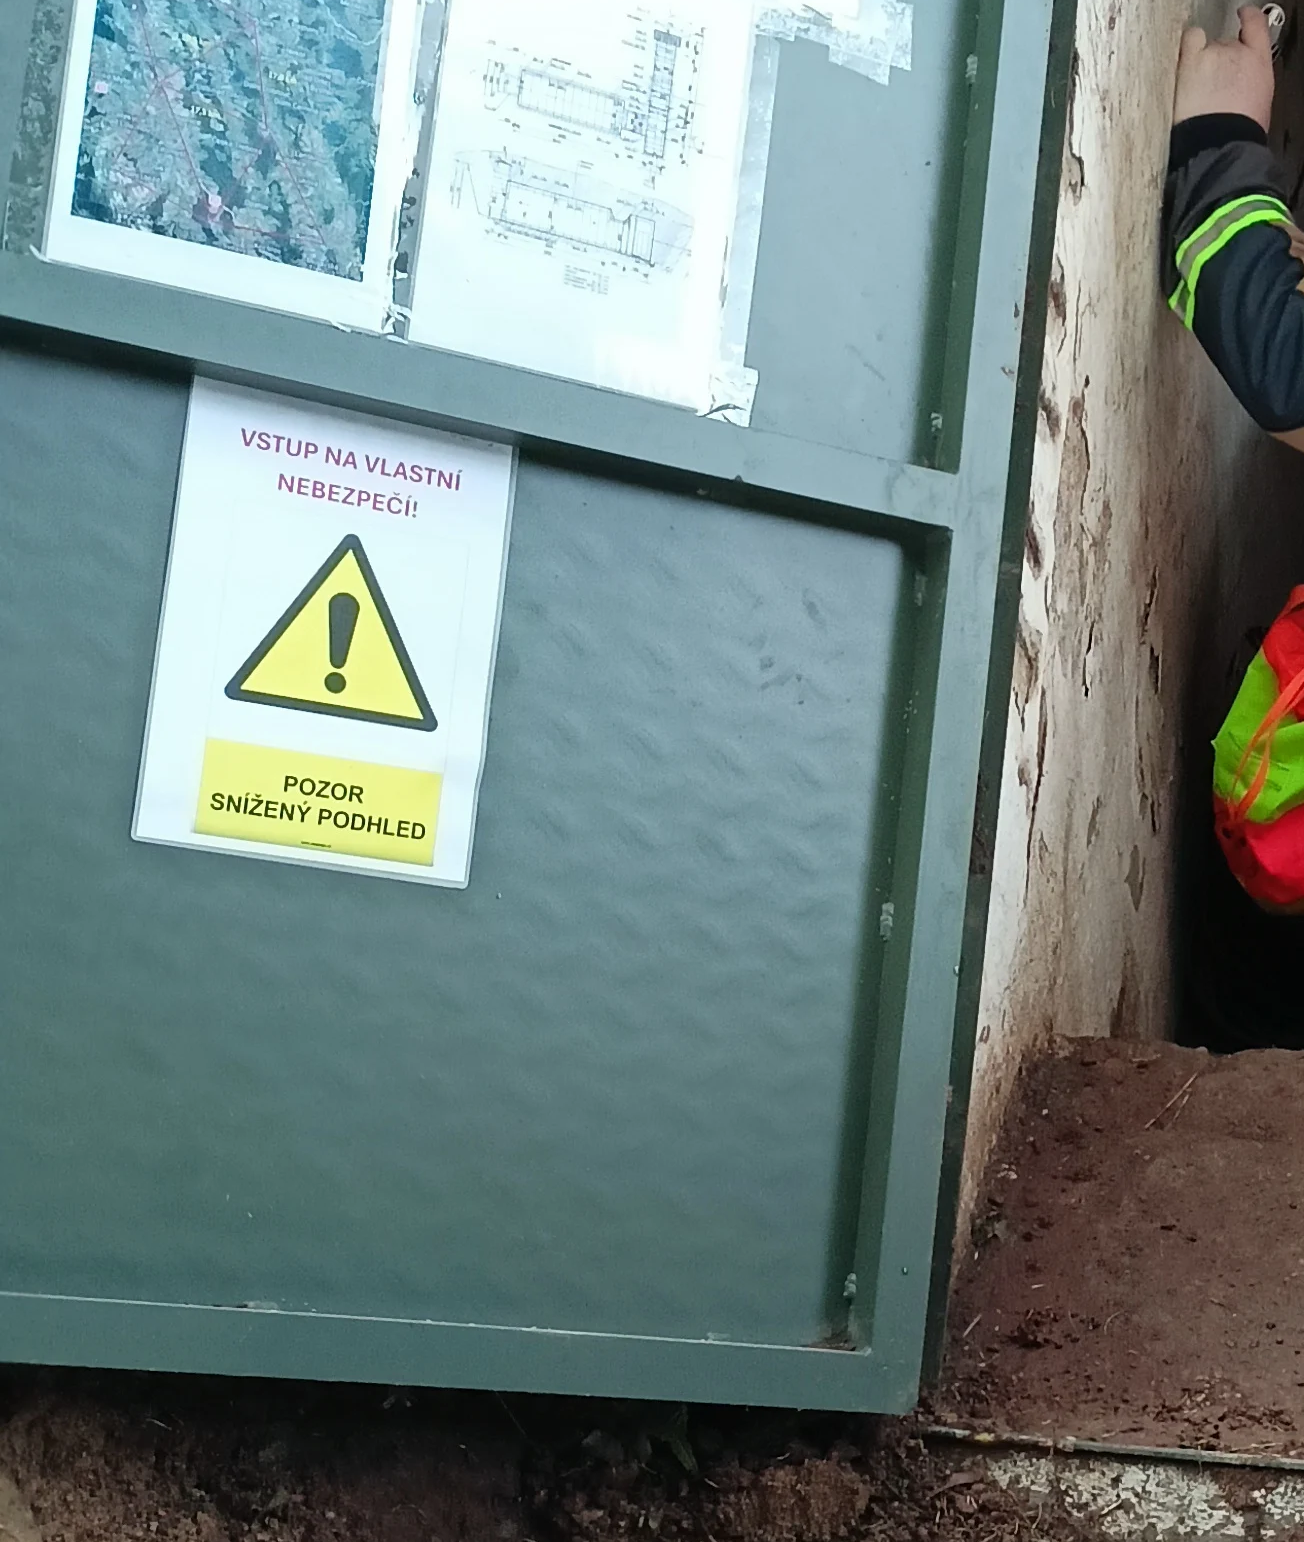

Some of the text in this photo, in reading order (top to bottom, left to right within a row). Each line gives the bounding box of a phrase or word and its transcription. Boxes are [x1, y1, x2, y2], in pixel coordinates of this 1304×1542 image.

[240, 427, 465, 492] VSTUP NA VLASTNÍ
[277, 472, 419, 519] NEBEZPEČÍ!
[283, 774, 365, 805] POZOR
[209, 791, 428, 841] SNÍŽENÝ PODHLED
